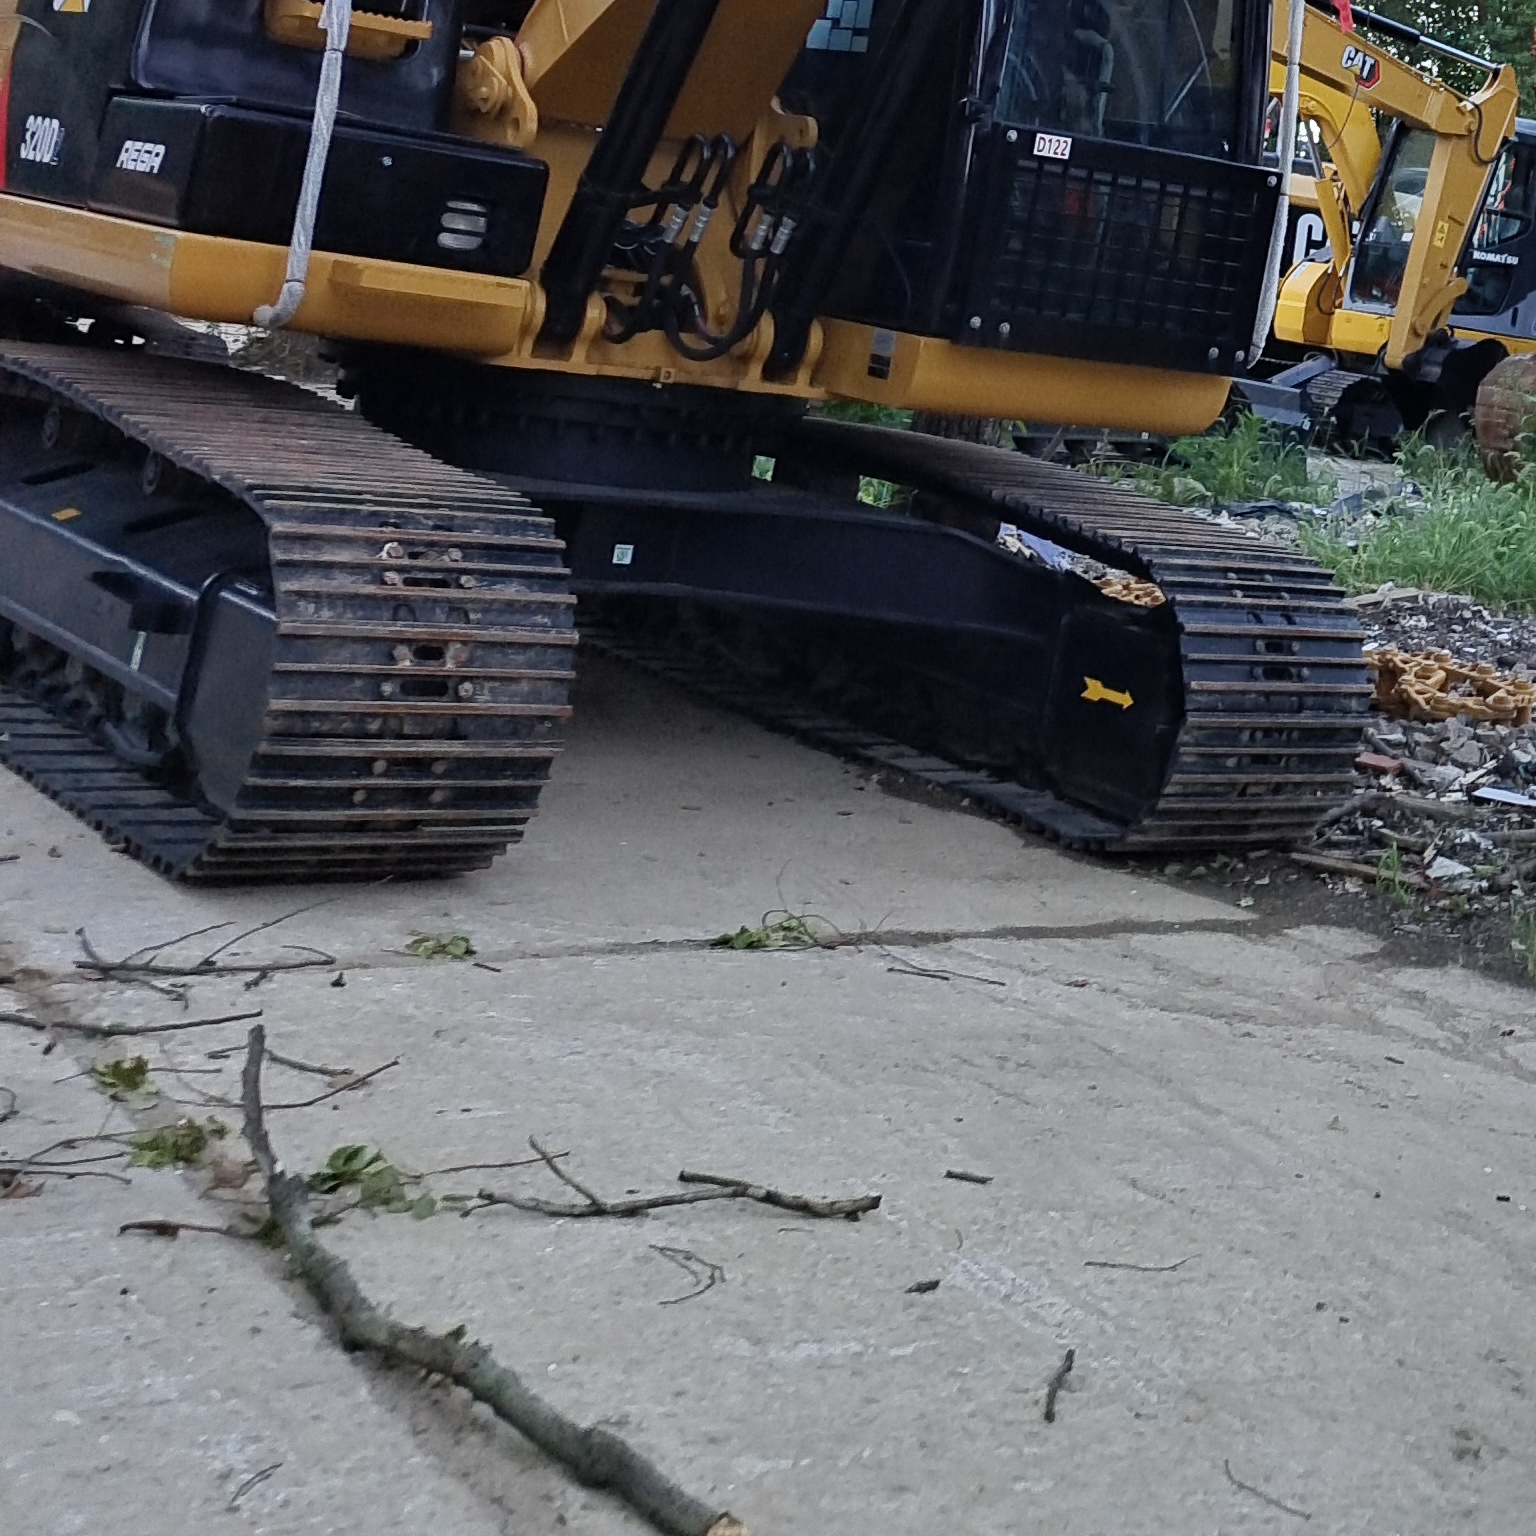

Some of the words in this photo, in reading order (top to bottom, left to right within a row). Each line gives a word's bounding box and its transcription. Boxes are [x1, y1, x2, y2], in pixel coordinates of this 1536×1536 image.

[1341, 45, 1376, 79] CAT
[1037, 136, 1068, 156] D122
[1473, 250, 1519, 265] KOMATSU
